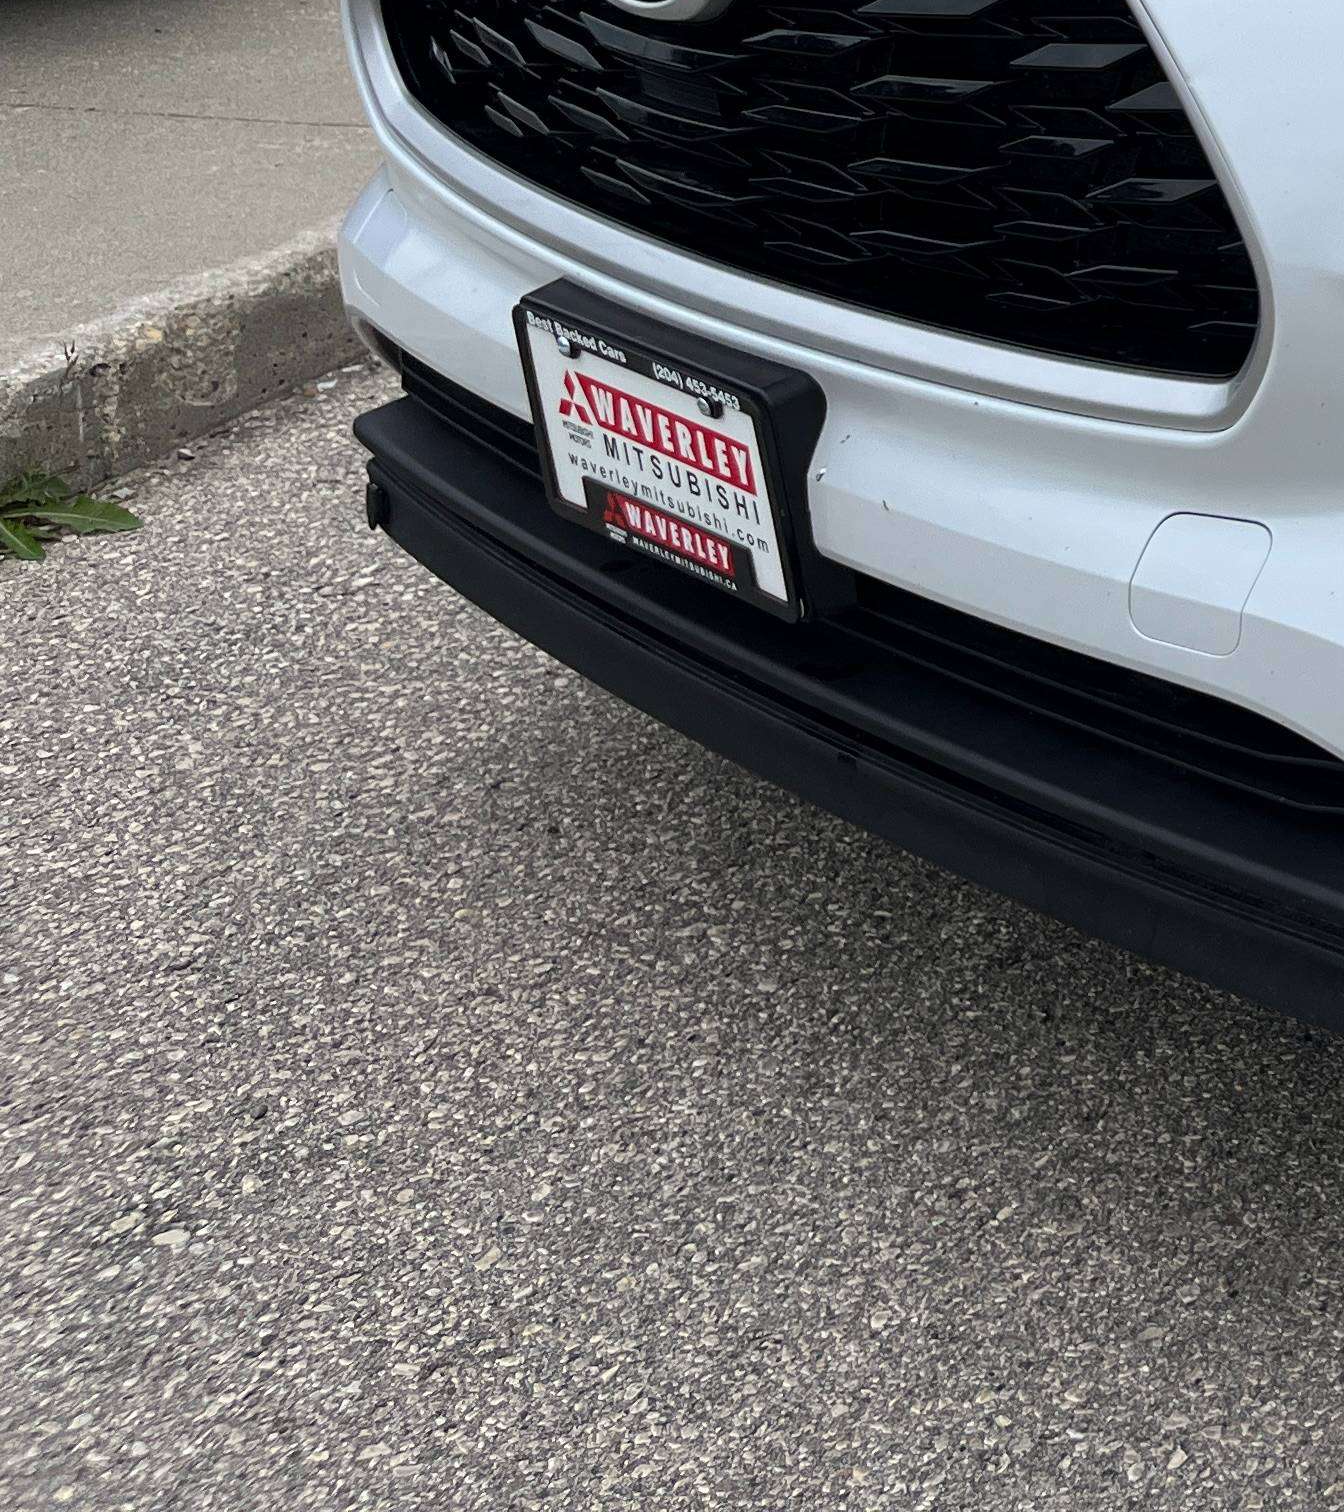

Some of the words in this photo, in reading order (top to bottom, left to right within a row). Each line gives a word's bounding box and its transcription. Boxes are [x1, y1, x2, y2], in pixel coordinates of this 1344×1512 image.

[526, 310, 554, 333] Best
[553, 321, 598, 351] Backed
[598, 340, 627, 363] Cars
[652, 362, 684, 390] (204)
[686, 377, 741, 411] 453-5453
[590, 384, 750, 487] WAVERLEY
[568, 451, 770, 554] waverleymitsubishi.com
[603, 433, 760, 525] MITSUBISHI
[624, 501, 729, 570] WAVERLEY
